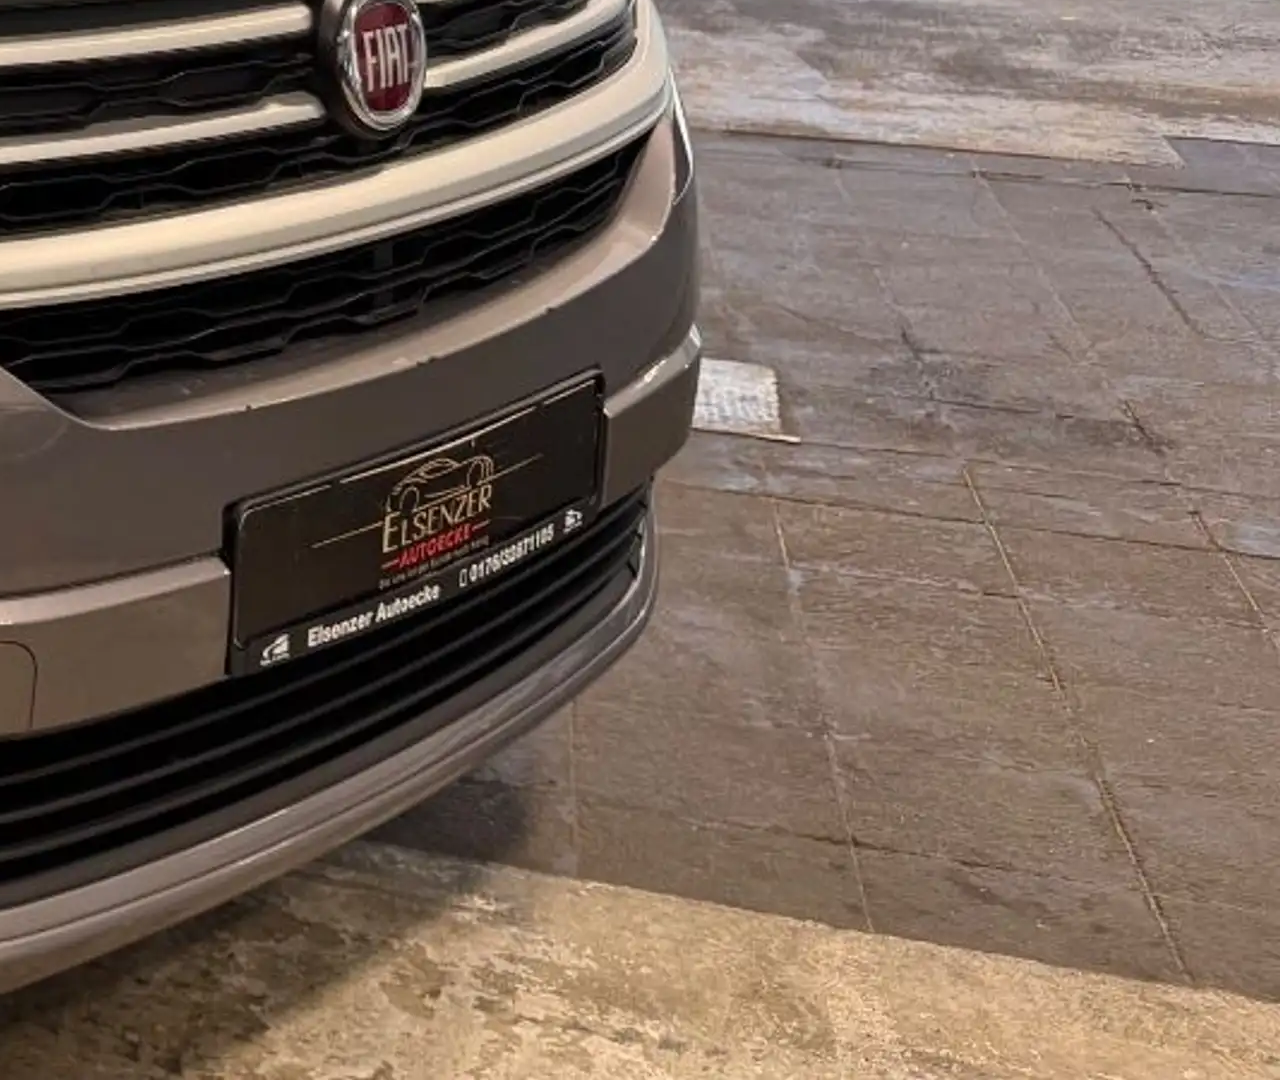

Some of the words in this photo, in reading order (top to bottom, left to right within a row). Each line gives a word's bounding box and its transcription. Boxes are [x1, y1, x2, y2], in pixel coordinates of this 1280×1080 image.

[361, 23, 409, 93] FIAT
[381, 484, 492, 554] ELSENZER
[307, 610, 374, 648] Elsenzer
[375, 584, 441, 623] Autoecke
